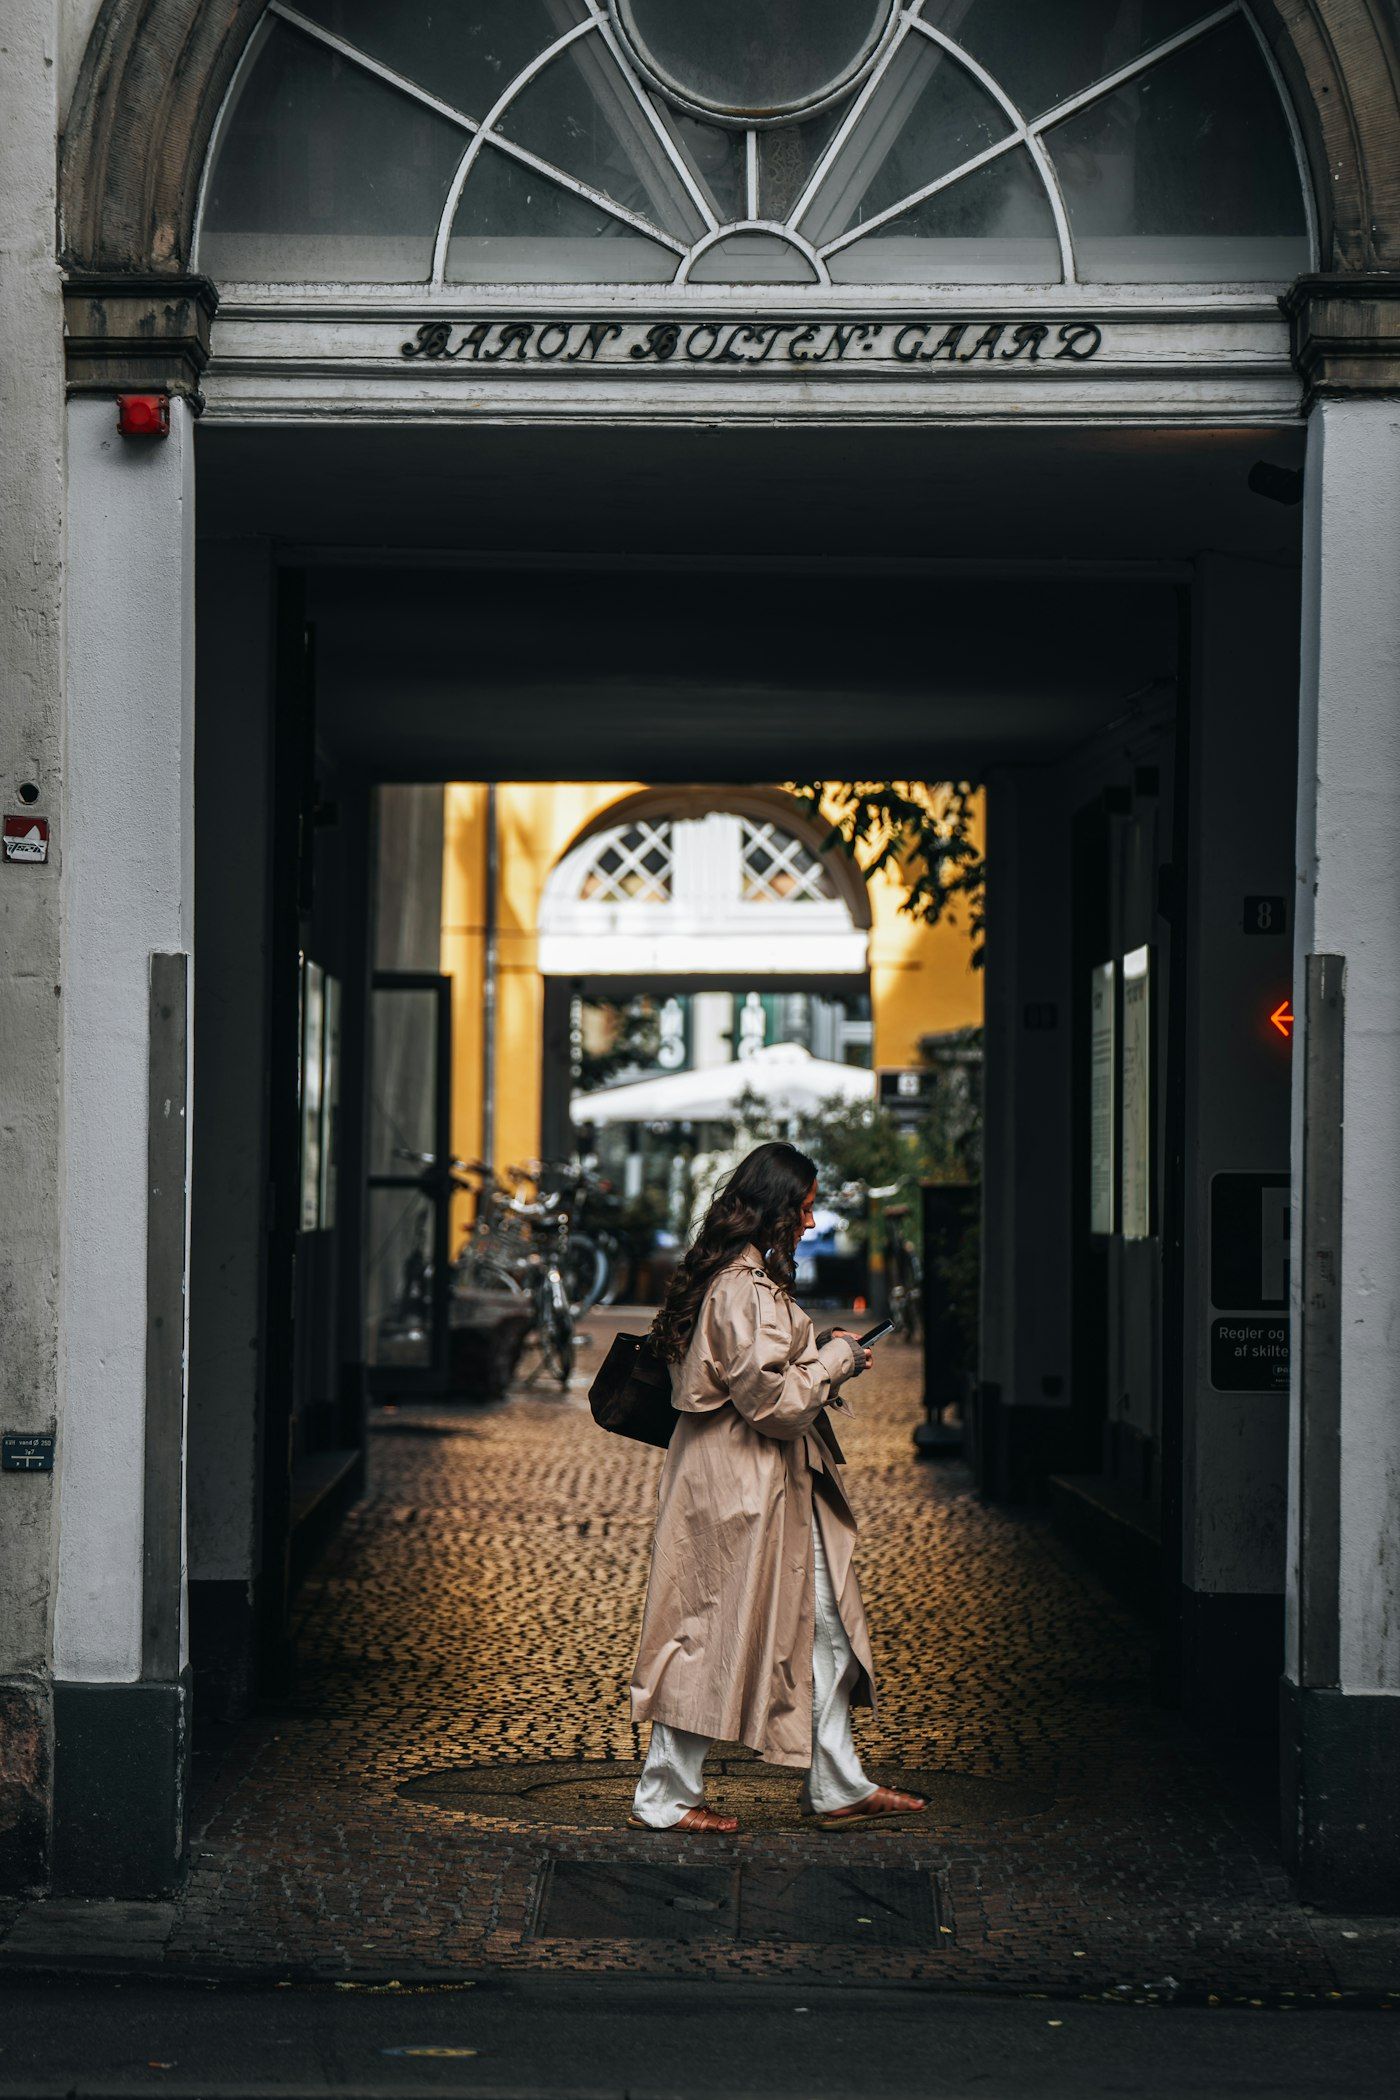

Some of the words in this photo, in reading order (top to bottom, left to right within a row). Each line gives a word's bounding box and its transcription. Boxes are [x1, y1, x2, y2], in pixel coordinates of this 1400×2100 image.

[401, 322, 622, 361] BARON
[893, 323, 1102, 361] GAARD
[1257, 902, 1272, 929] 8
[1219, 1327, 1263, 1341] Regler
[1268, 1330, 1285, 1341] og
[1234, 1345, 1247, 1357] af
